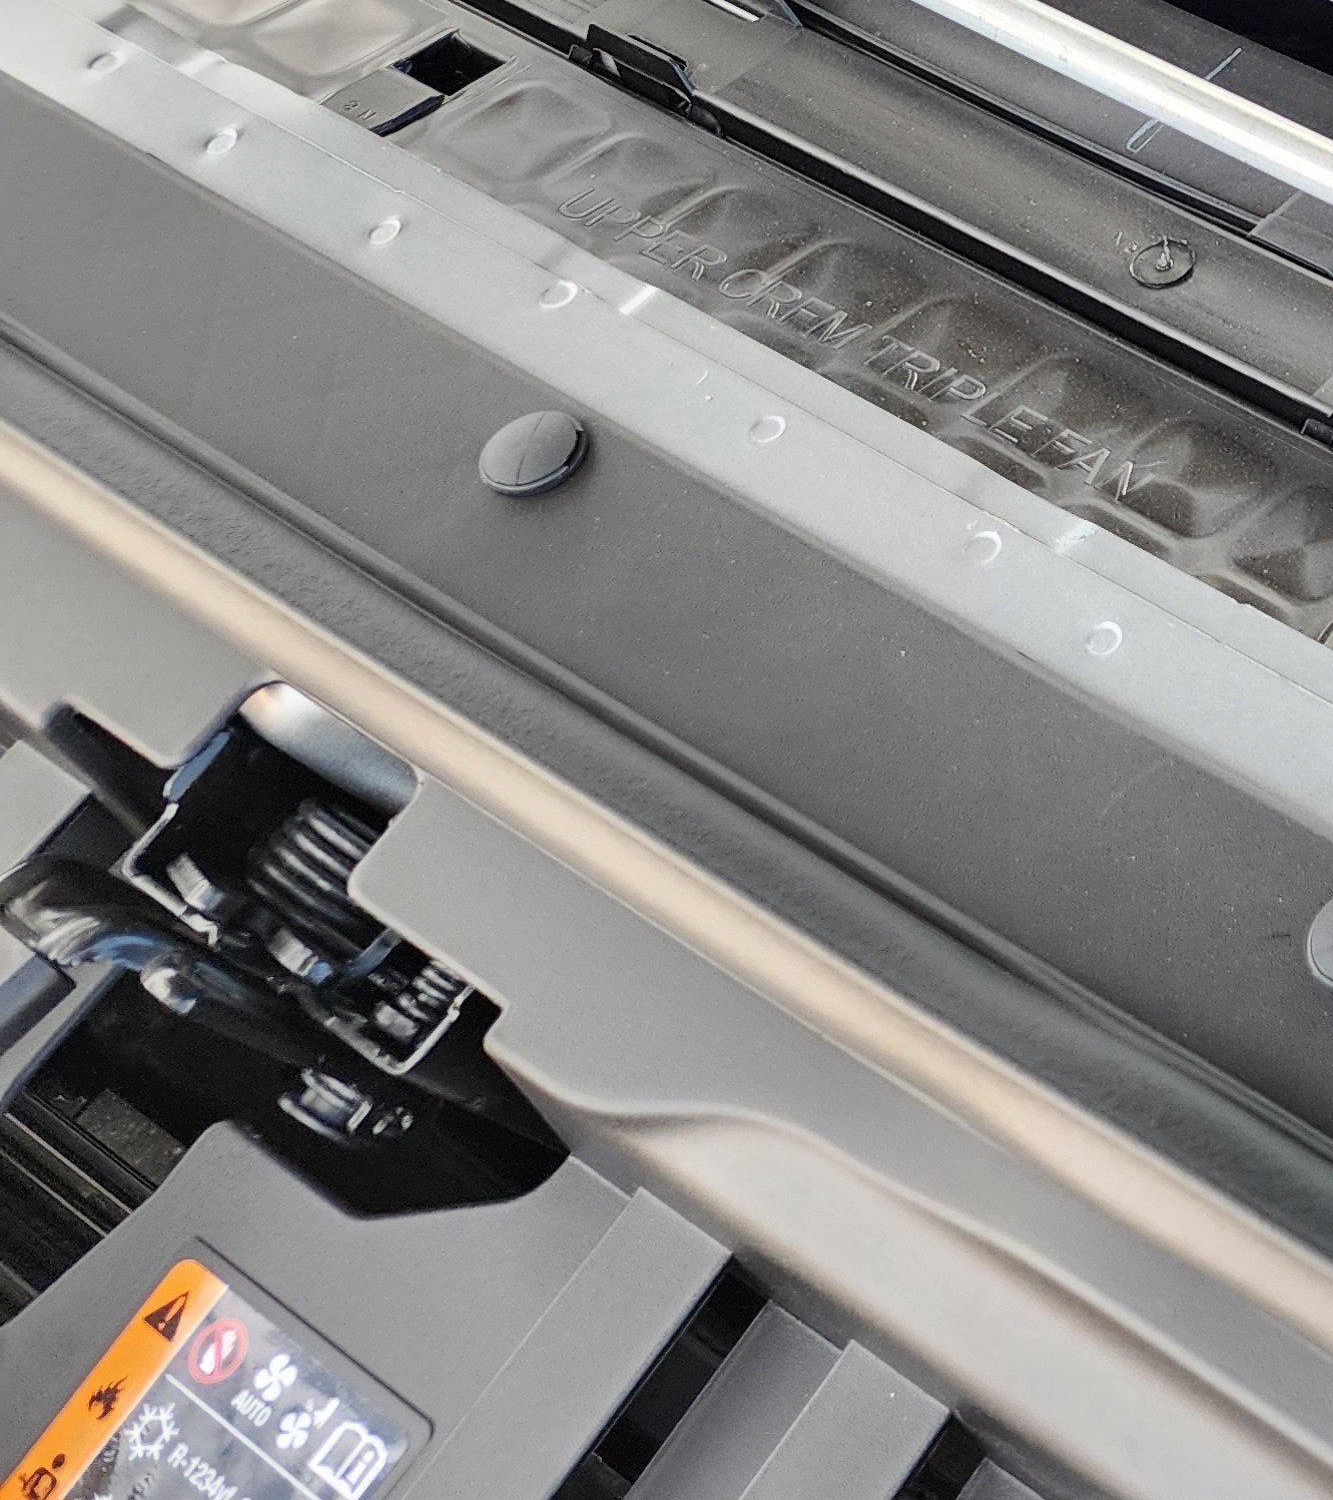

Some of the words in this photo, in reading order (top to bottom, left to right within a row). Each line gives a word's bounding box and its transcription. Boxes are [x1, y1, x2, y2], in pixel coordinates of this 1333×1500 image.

[557, 188, 728, 281] UPPER
[719, 268, 872, 351] CRFM
[863, 334, 1048, 444] TRIPLE
[1031, 428, 1168, 504] FAN
[231, 1389, 273, 1427] AUTO
